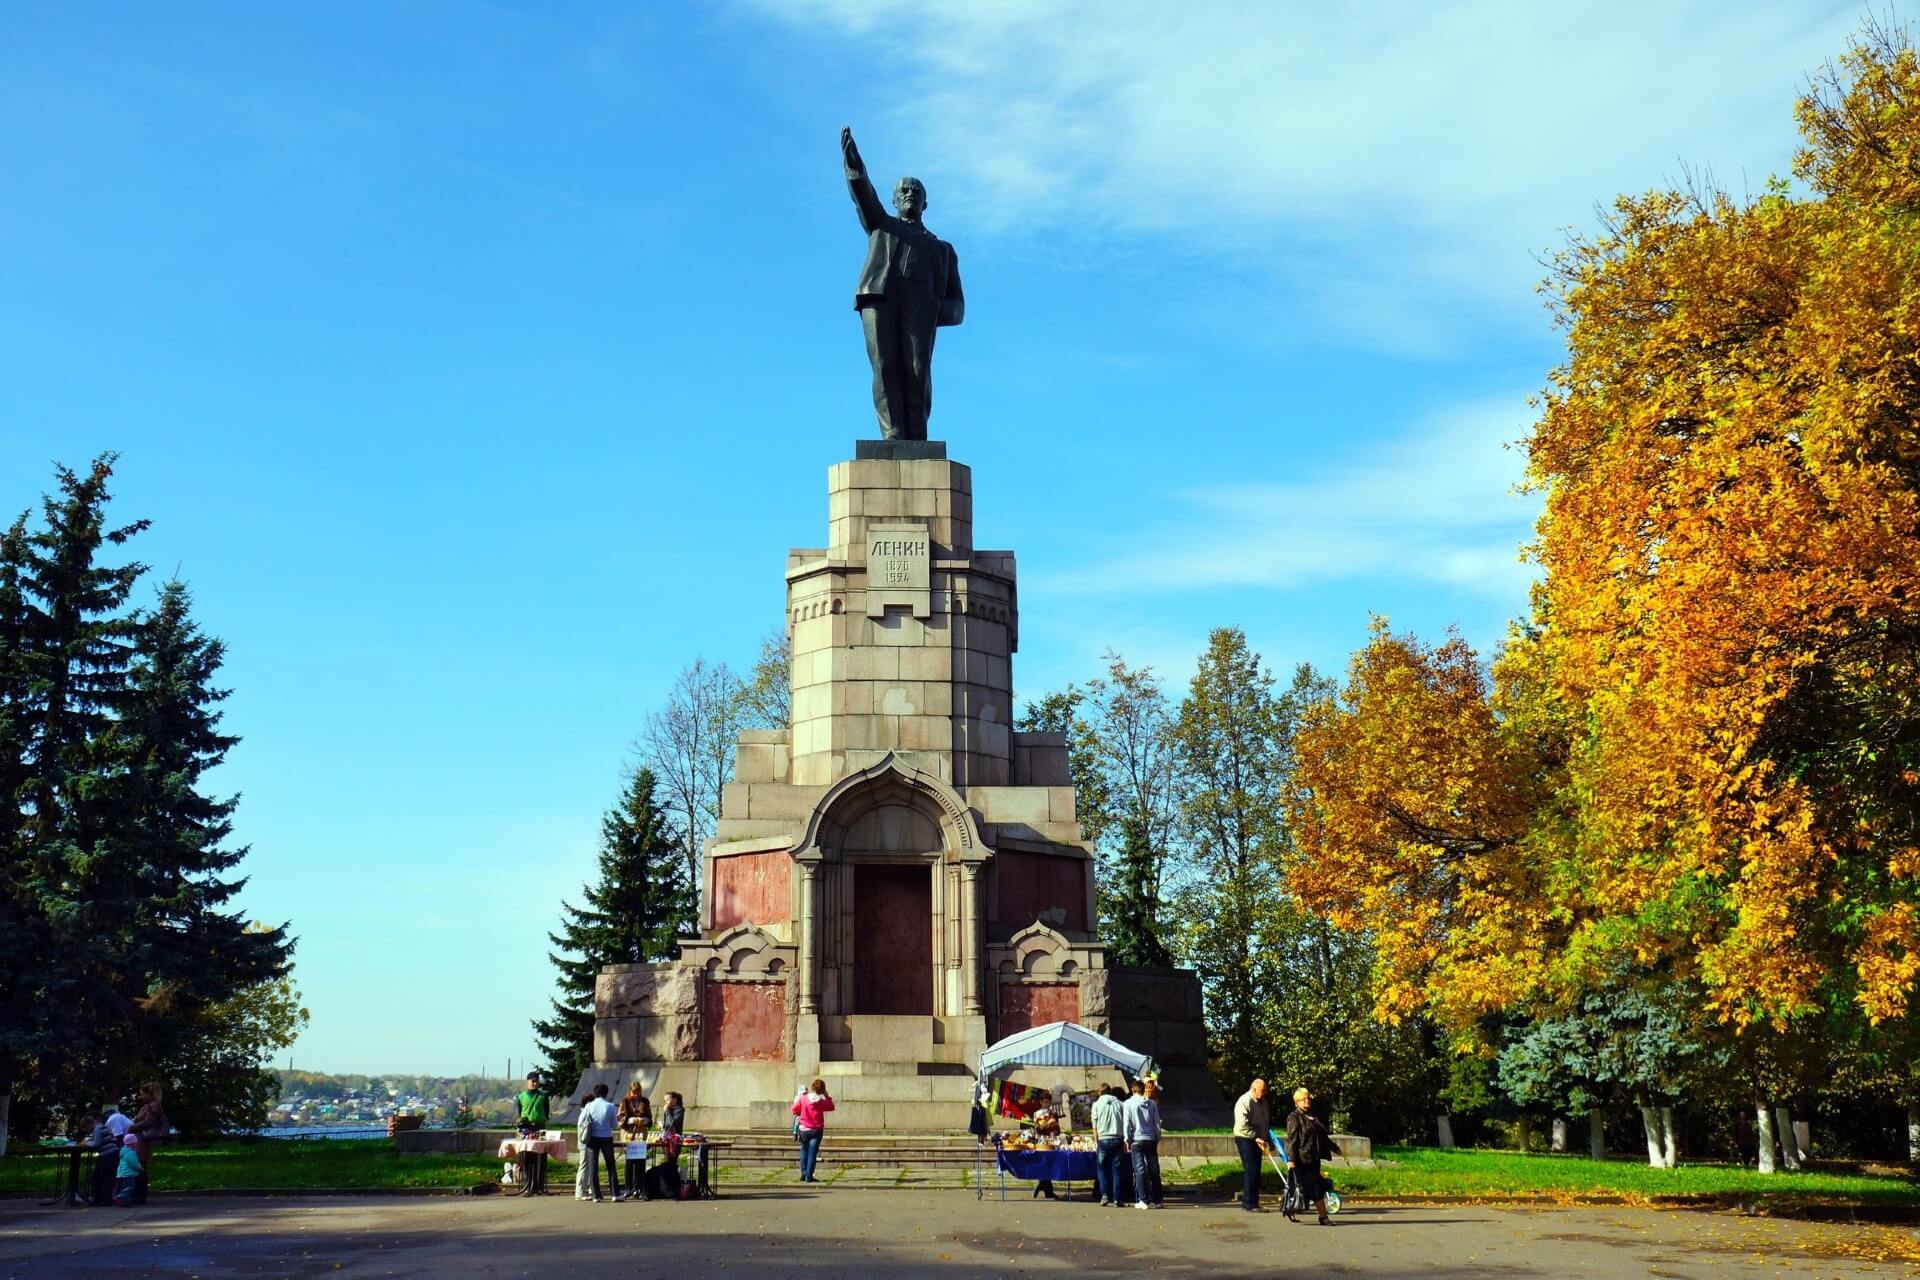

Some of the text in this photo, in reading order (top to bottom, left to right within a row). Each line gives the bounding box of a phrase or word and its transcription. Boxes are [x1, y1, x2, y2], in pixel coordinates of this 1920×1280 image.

[871, 541, 925, 556] ЛЕНИН
[886, 560, 909, 571] 1870
[886, 572, 909, 583] 1924
